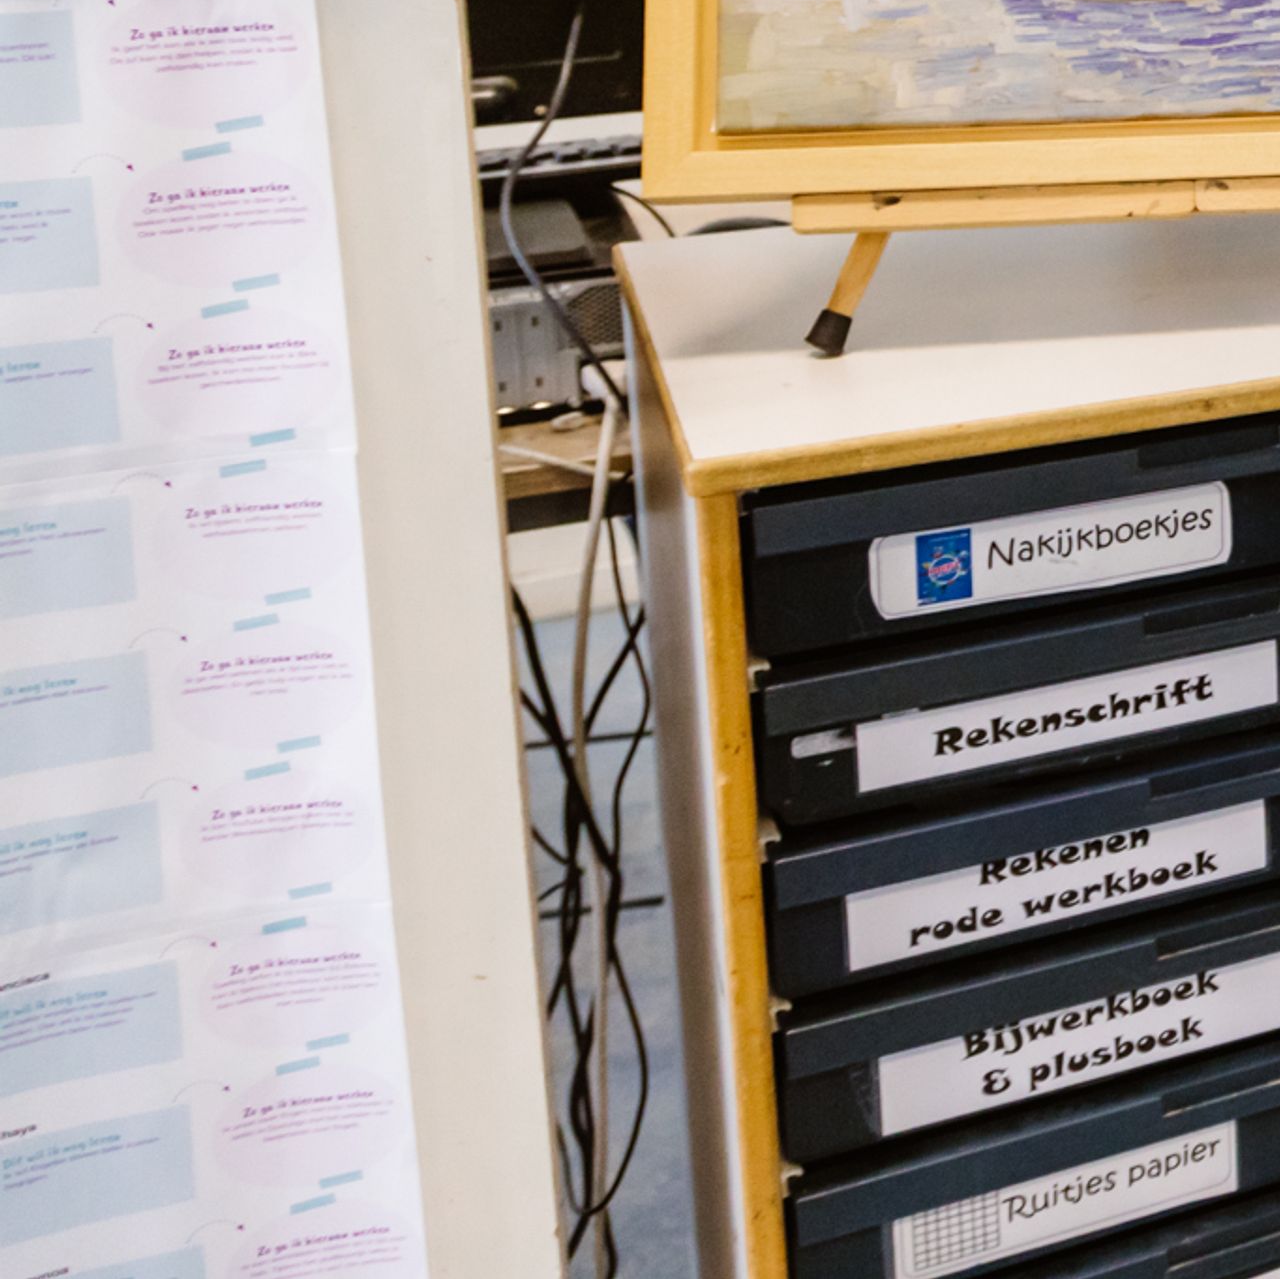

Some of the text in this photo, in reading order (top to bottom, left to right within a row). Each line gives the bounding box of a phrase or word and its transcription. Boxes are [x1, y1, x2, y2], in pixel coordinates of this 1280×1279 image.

[987, 507, 1214, 570] Nakijkboekjes
[933, 674, 1213, 756] Rekenschrift
[978, 827, 1151, 886] Rekenen
[909, 850, 1219, 948] rode werkboek
[962, 970, 1220, 1061] Bijwerkboek
[982, 1017, 1204, 1096] & plusboek
[1002, 1138, 1221, 1223] Ruitjes papier
